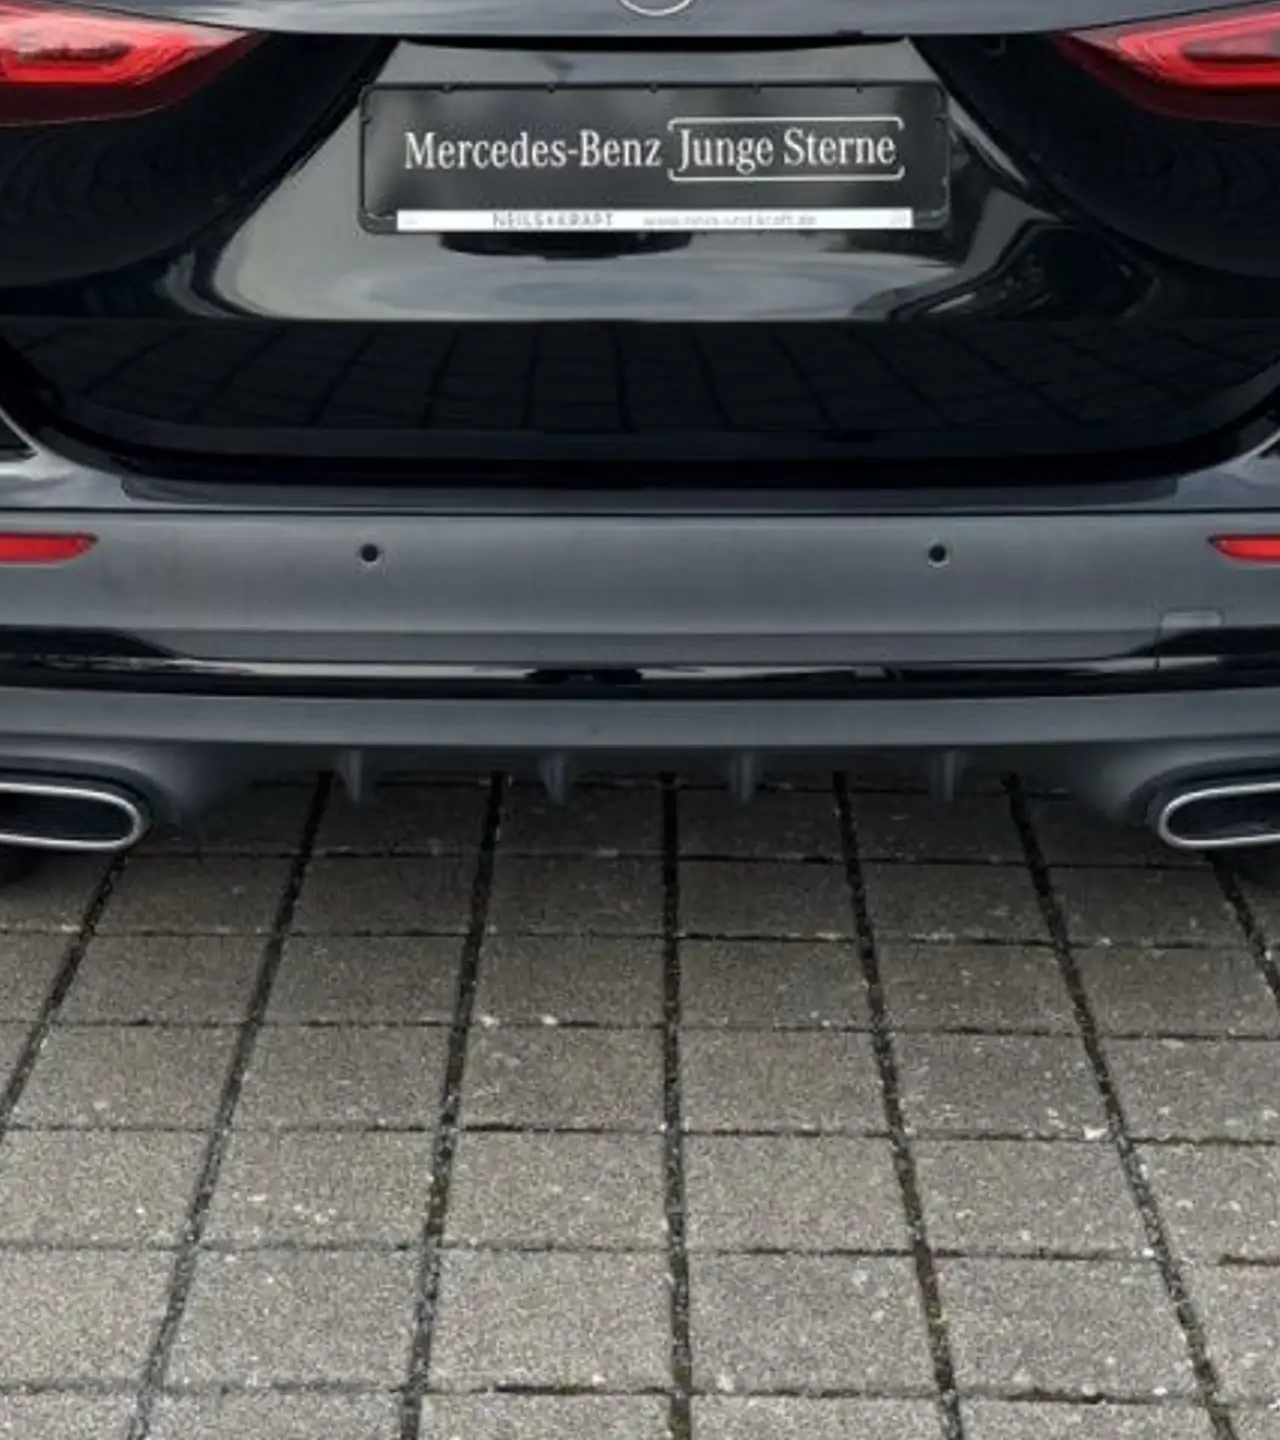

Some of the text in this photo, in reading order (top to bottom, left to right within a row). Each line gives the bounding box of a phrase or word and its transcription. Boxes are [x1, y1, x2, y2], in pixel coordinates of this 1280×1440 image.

[404, 127, 896, 174] Mercedes-Benz Junge Sterne
